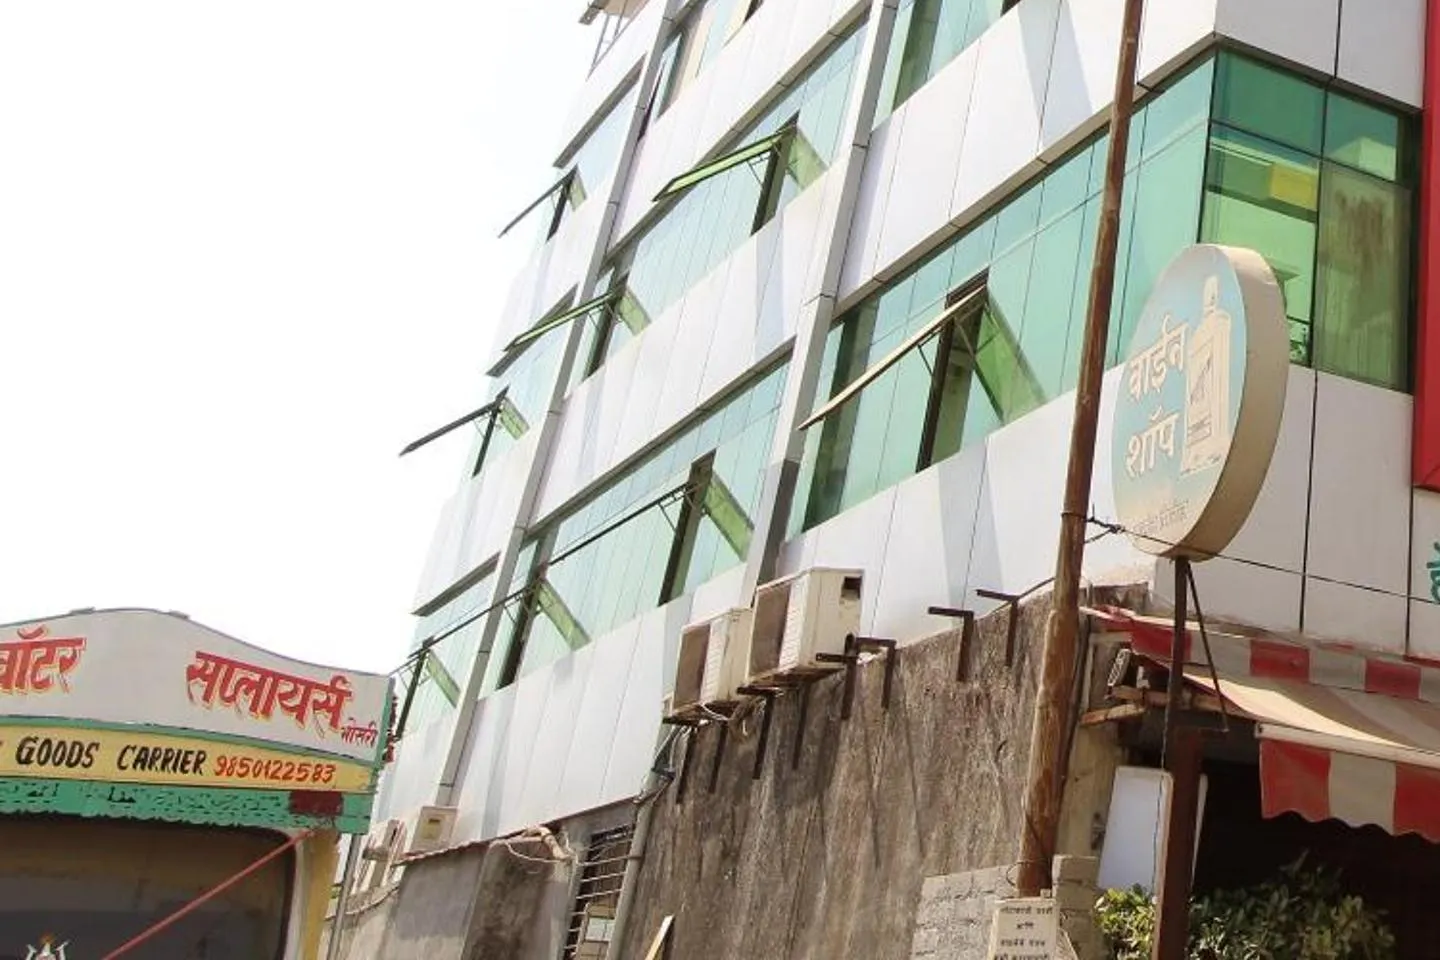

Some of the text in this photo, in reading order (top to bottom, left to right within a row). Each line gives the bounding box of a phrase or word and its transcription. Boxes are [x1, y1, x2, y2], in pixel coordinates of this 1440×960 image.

[1129, 314, 1189, 401] वाईन
[1126, 406, 1180, 478] शॉप
[186, 651, 352, 738] सप्लायर्स
[16, 736, 336, 783] GOODS CARRIER 9850122583
